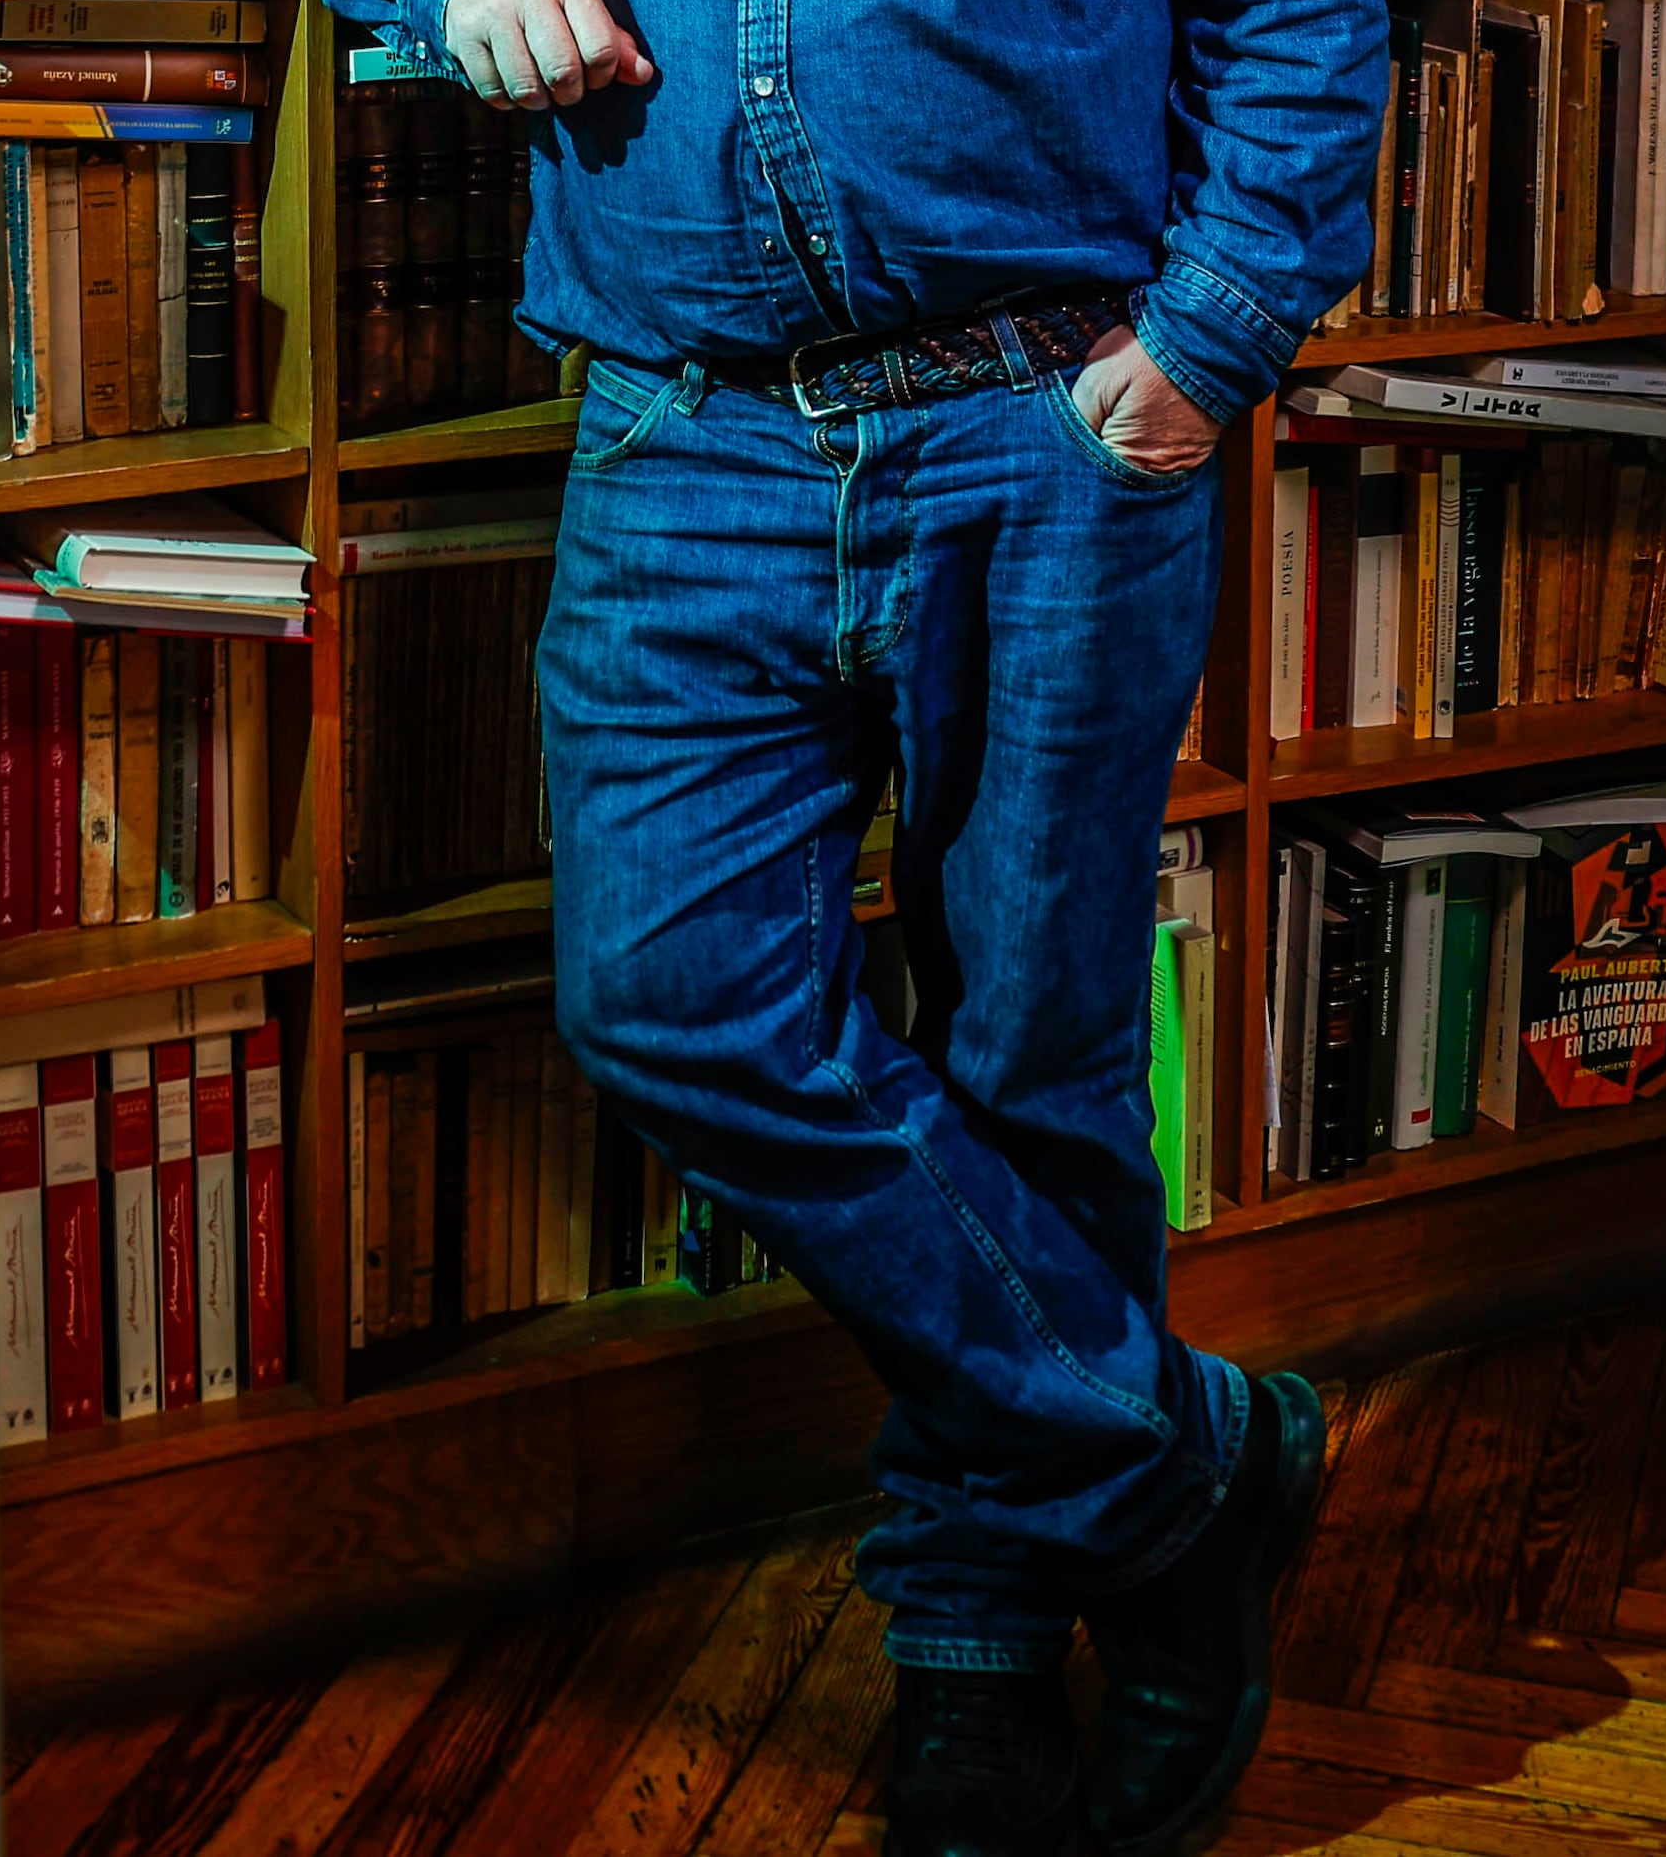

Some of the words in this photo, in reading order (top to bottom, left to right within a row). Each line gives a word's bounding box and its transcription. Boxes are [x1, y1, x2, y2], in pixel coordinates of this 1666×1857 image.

[43, 70, 75, 83] Azaña
[77, 71, 118, 83] Manuel
[1651, 61, 1660, 78] LO
[1649, 85, 1659, 120] VILLA
[1648, 121, 1658, 165] MORENO
[1280, 529, 1294, 597] POESÍA
[1560, 964, 1600, 984] PAUL
[1558, 989, 1576, 1013] LA
[1530, 1018, 1549, 1043] DE
[1551, 1013, 1579, 1038] LAS
[1564, 1035, 1584, 1059] EN
[1588, 1022, 1652, 1054] ESPAÑA
